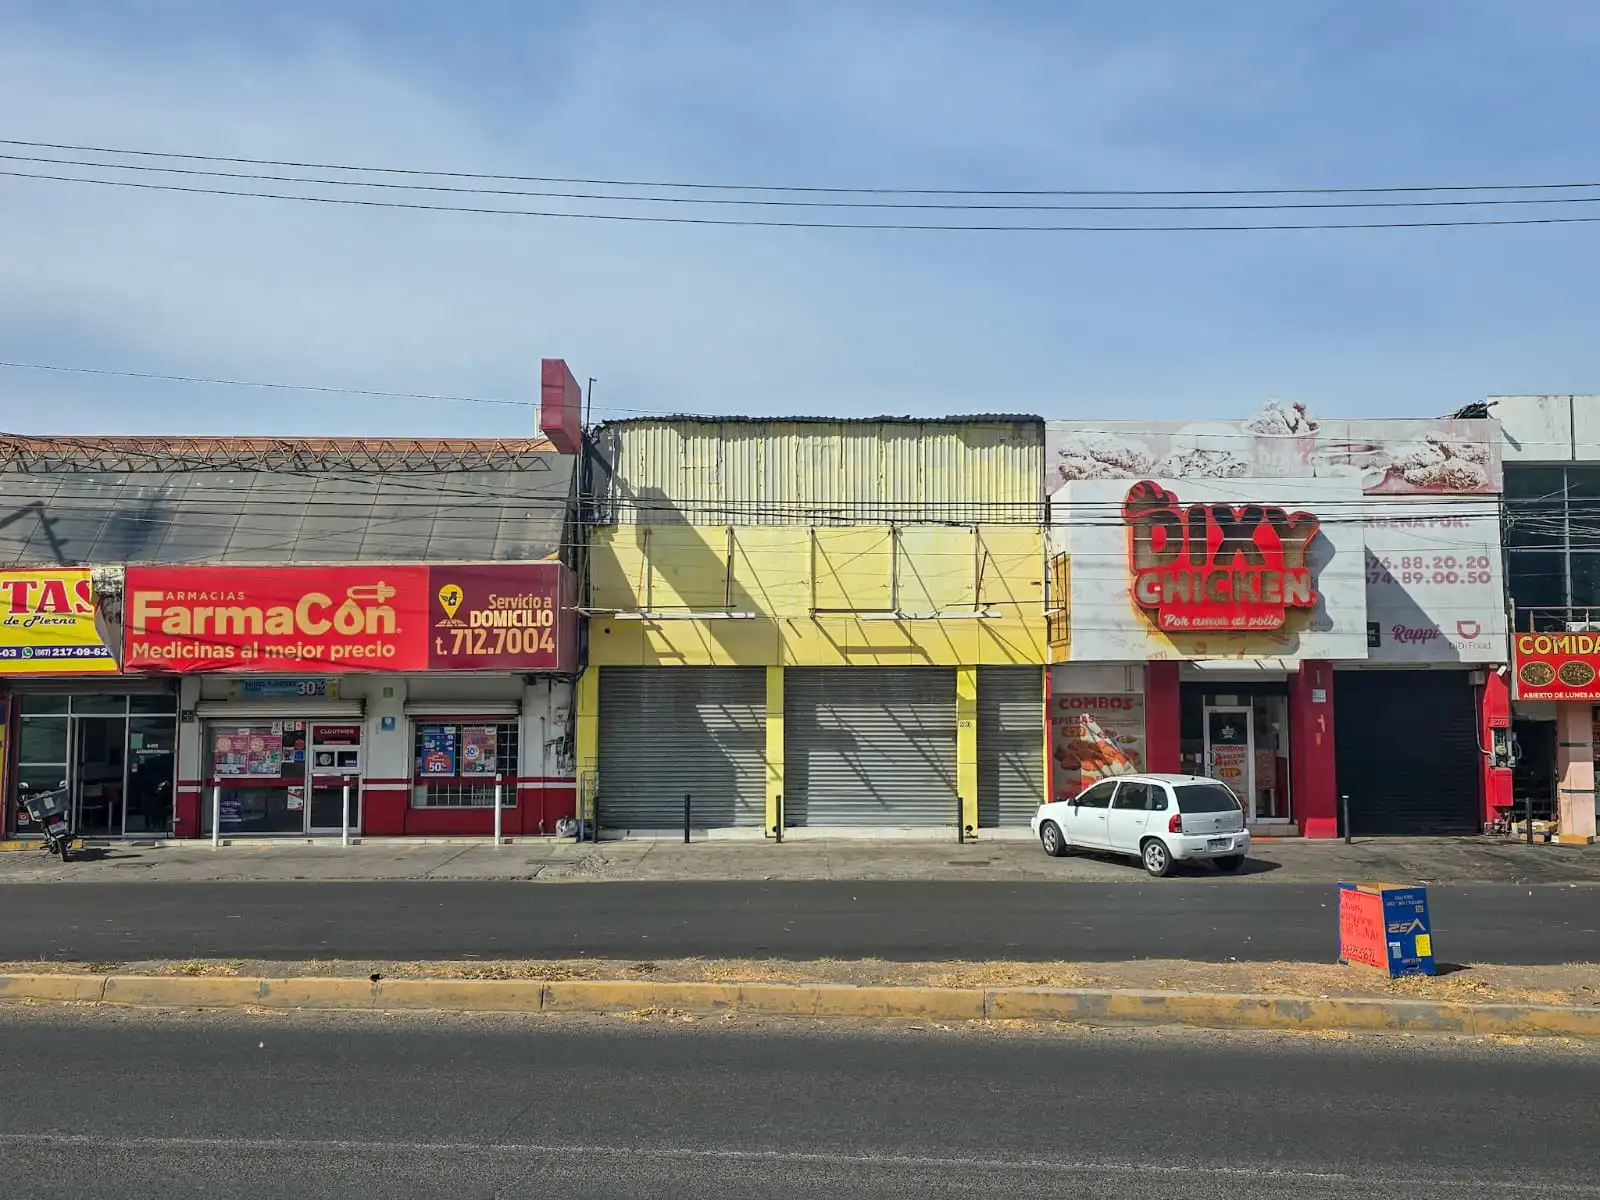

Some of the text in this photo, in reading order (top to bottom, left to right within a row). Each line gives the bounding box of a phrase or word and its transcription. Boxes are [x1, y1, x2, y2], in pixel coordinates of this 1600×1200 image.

[1132, 507, 1320, 571] DIXY
[1136, 570, 1311, 604] CHICKEN
[488, 593, 552, 609] Servicio a
[4, 615, 77, 627] de Pierna
[470, 609, 554, 628] DOMICILIO
[1164, 614, 1189, 627] Por
[1247, 613, 1284, 628] pollo
[1392, 623, 1440, 644] Rappi
[52, 648, 108, 656] 217-09-62
[132, 640, 396, 662] Medicinas al mejor precio
[1469, 640, 1491, 650] Food
[1059, 697, 1134, 710] COMBOS
